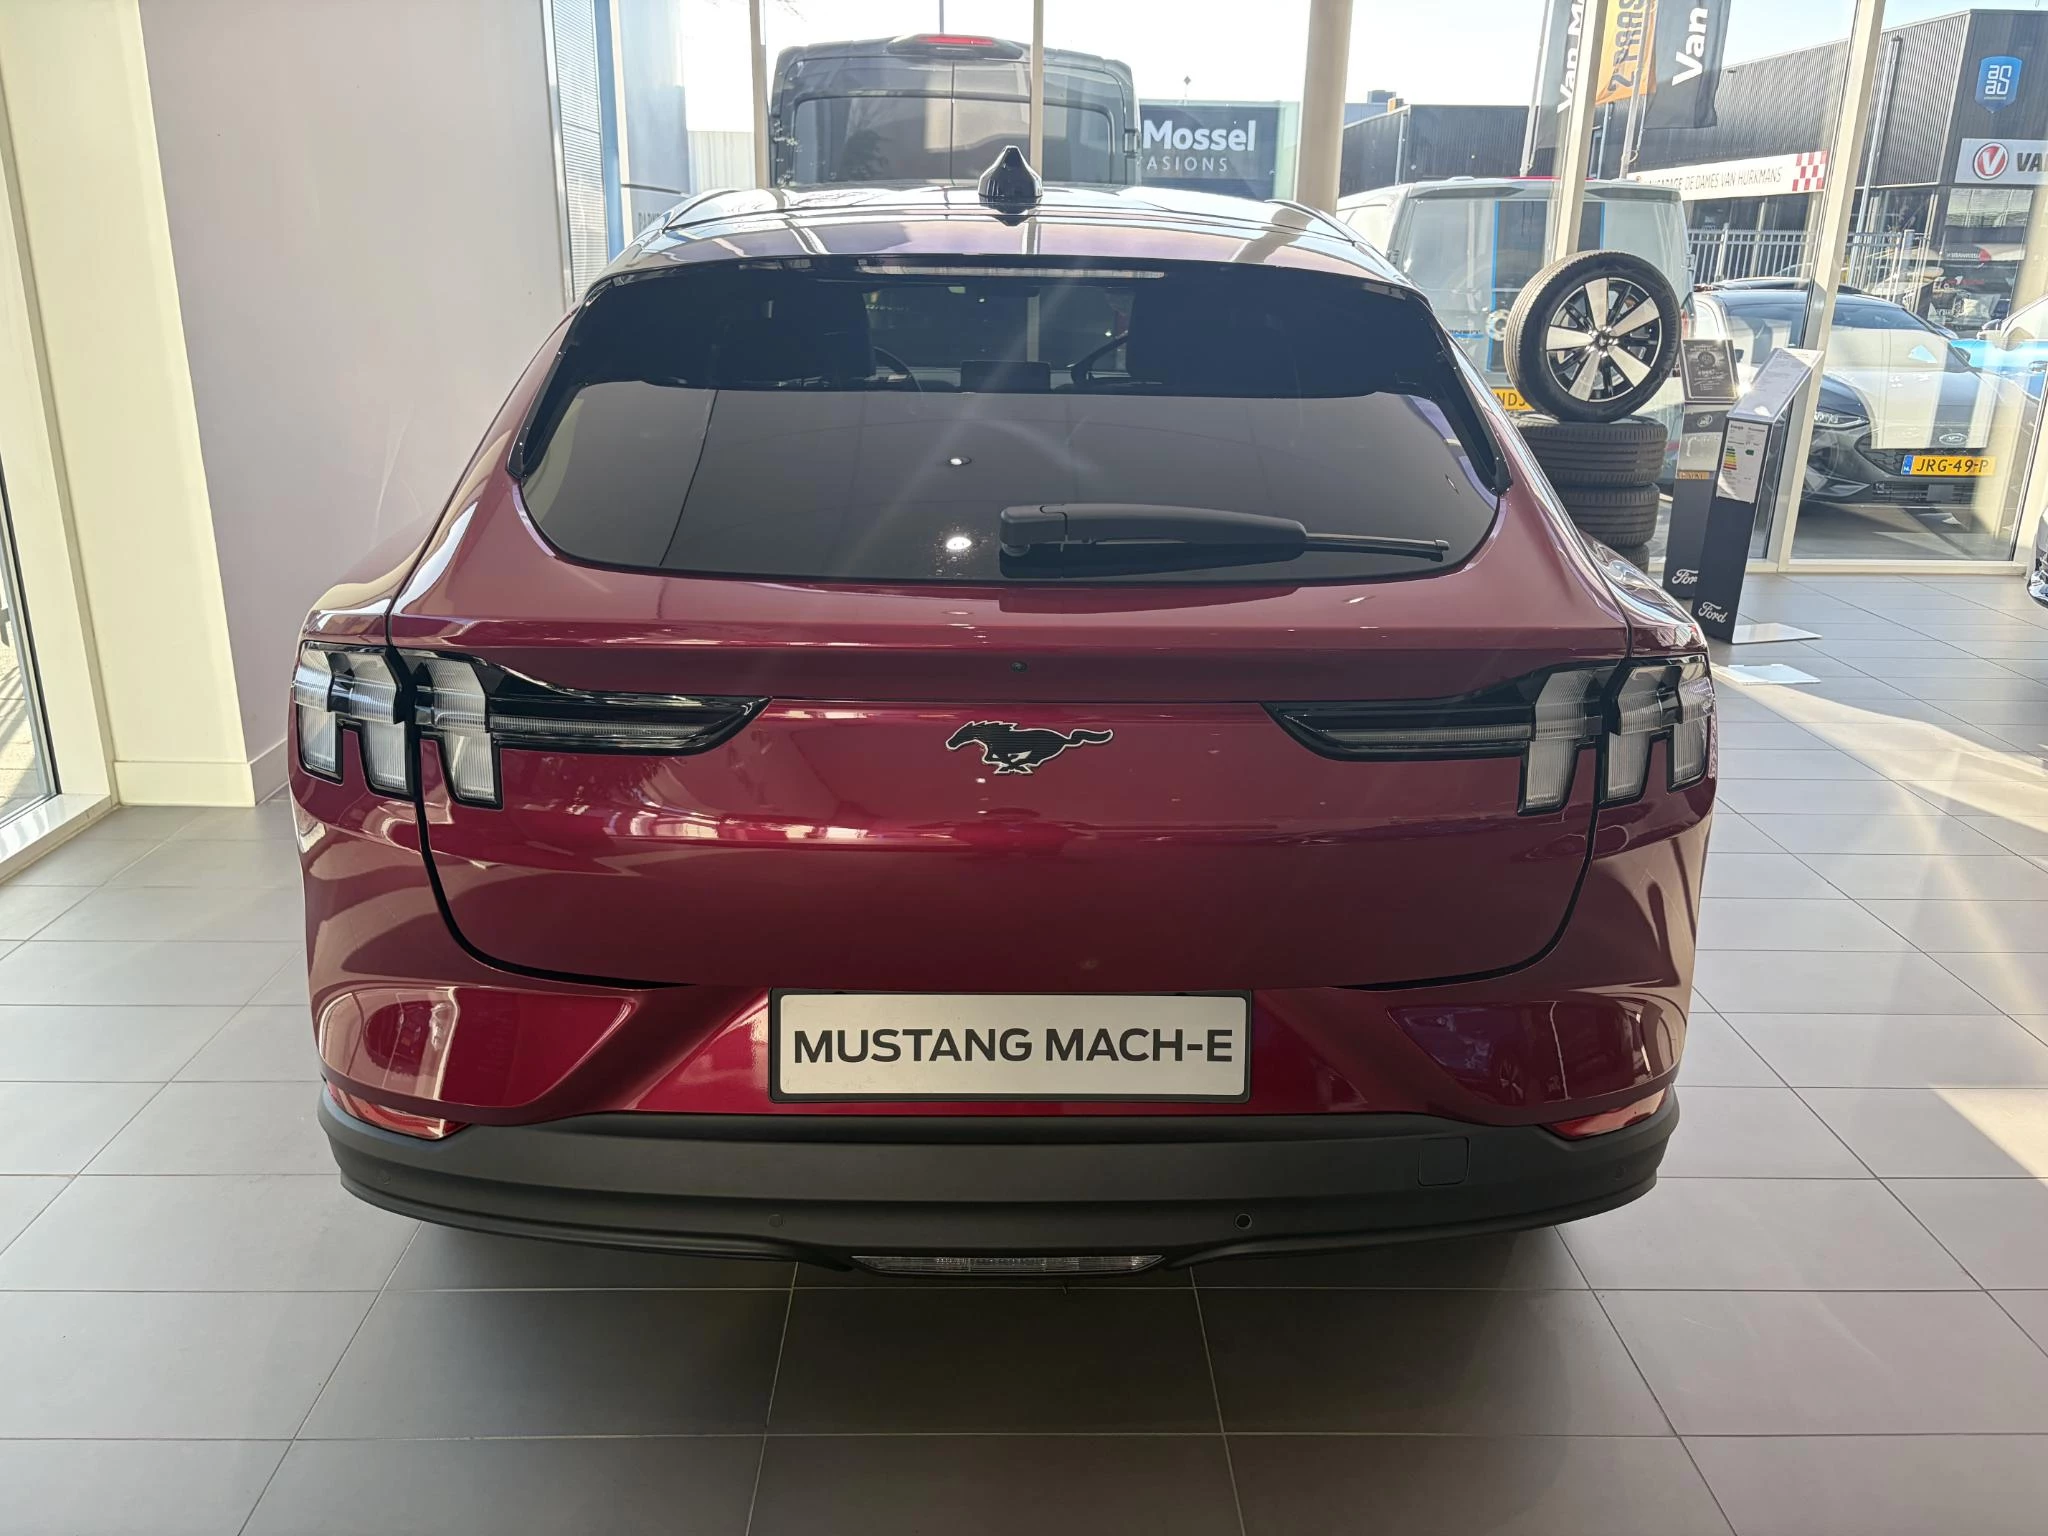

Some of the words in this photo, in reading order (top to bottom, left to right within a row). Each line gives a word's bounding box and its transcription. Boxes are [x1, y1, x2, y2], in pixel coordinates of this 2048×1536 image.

[1672, 7, 1709, 87] Van
[1556, 47, 1579, 113] Van
[1142, 119, 1257, 151] Mossel
[1140, 155, 1228, 172] ASIONS
[2017, 152, 2048, 172] VA
[1722, 171, 1737, 188] VAN
[1916, 458, 1989, 473] JRG-49-P
[1671, 568, 1699, 585] For
[1698, 601, 1729, 624] Ford
[793, 1027, 1033, 1064] MUSTANG
[1045, 1027, 1233, 1063] MACH-E
